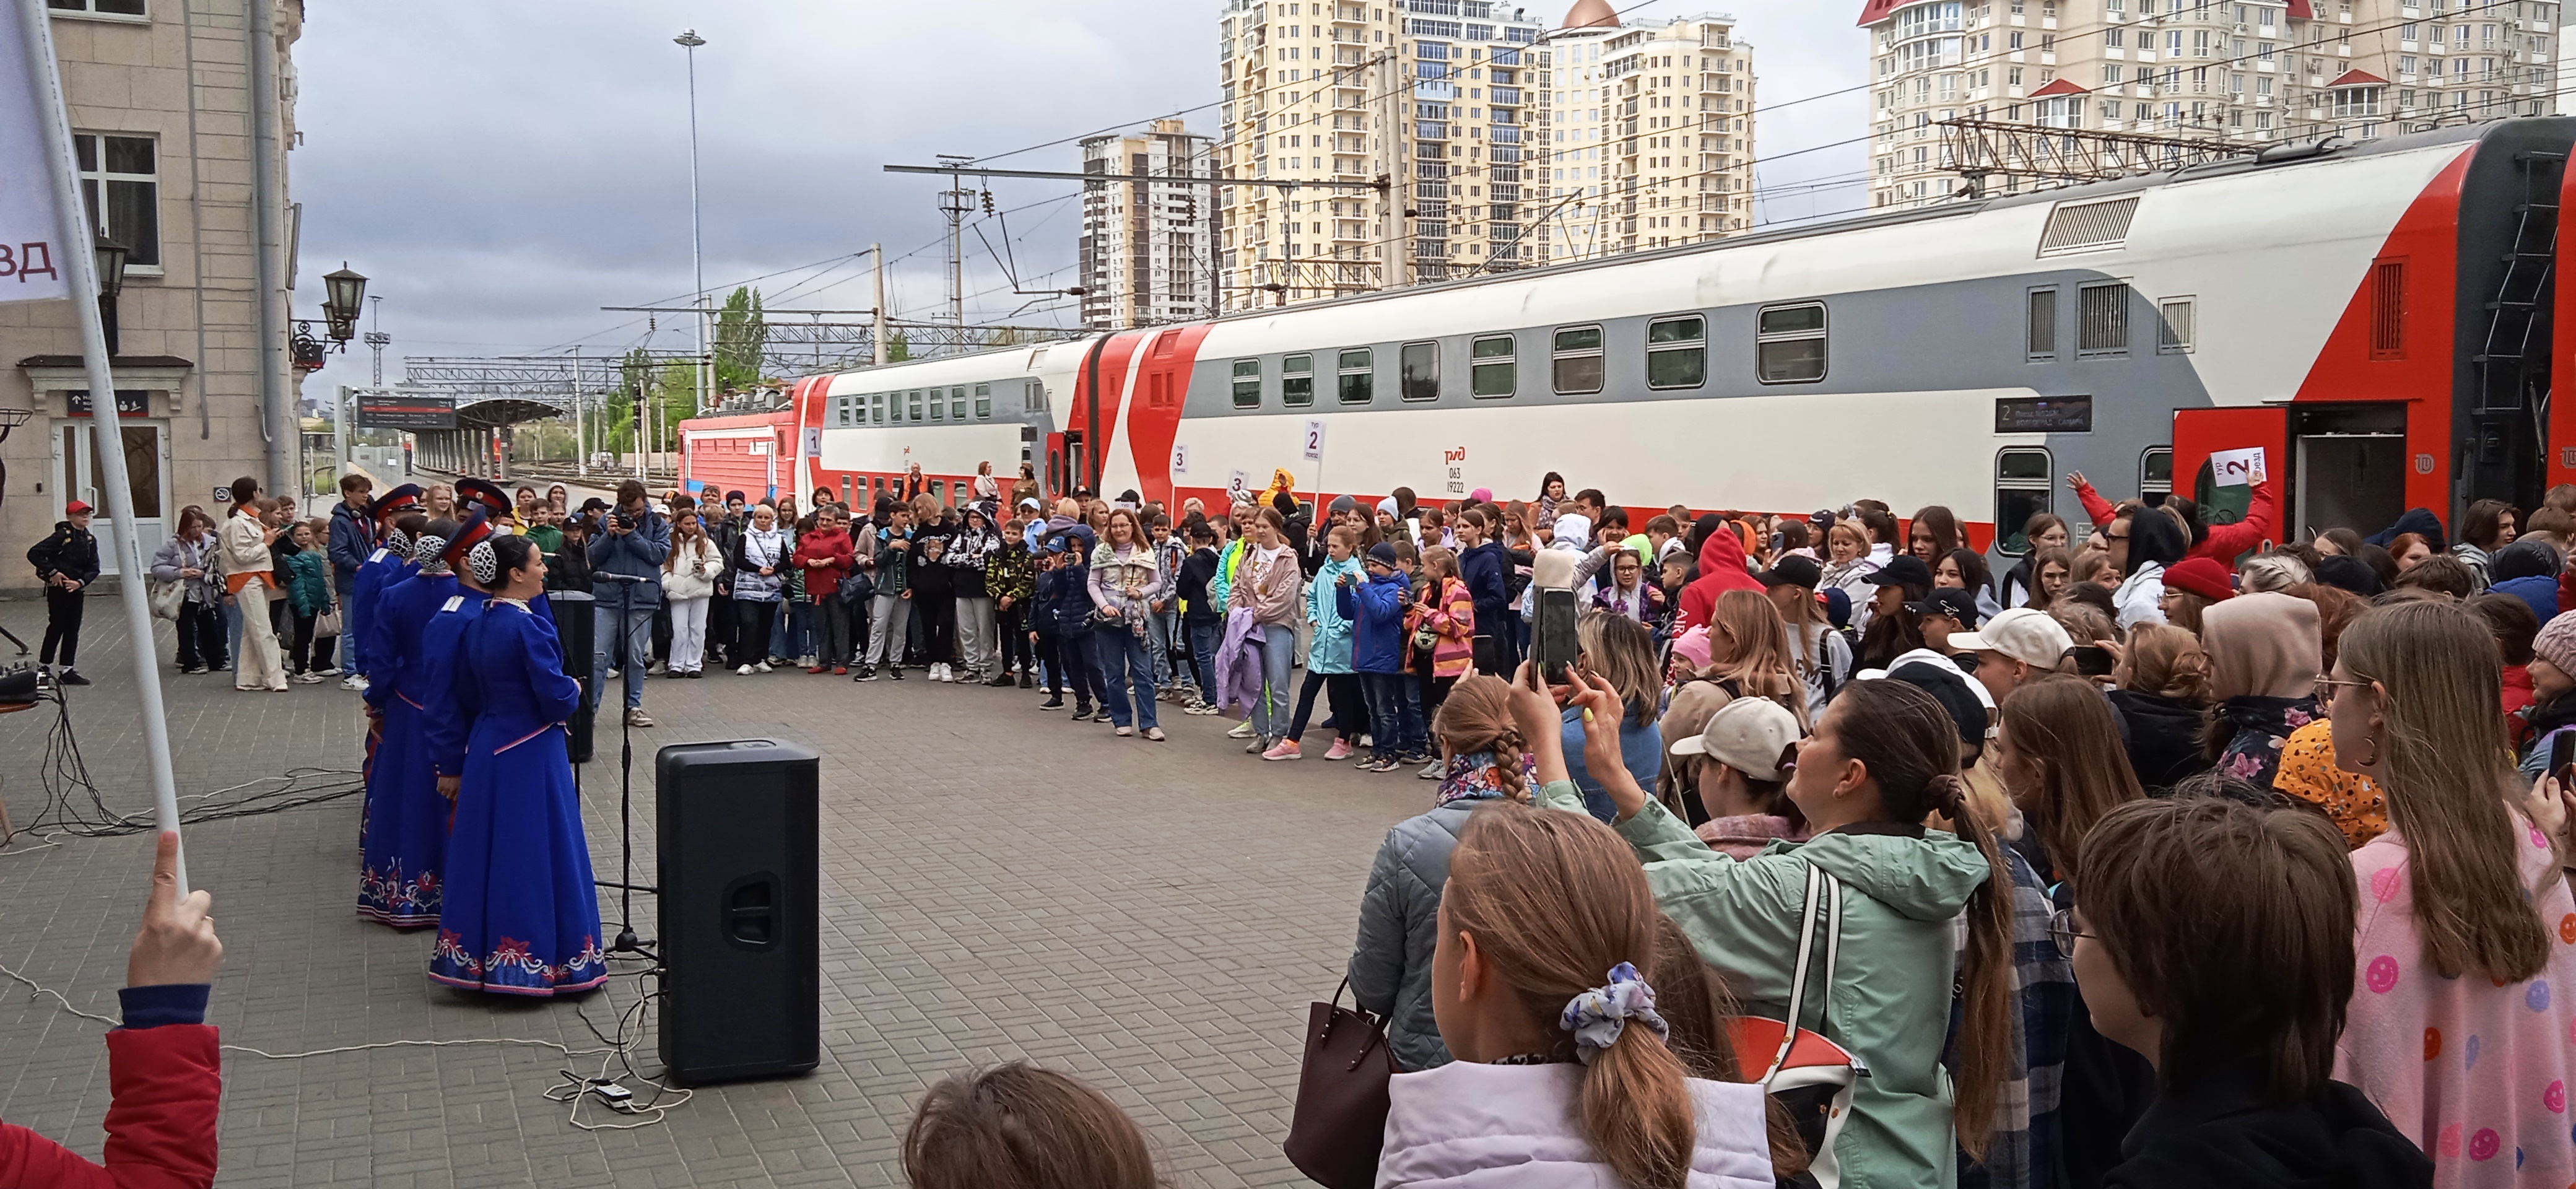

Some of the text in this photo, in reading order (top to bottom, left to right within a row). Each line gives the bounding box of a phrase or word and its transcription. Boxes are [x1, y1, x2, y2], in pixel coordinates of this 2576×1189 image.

[2002, 405, 2011, 421] 2
[811, 435, 817, 448] 1
[1308, 431, 1318, 450] 2
[1176, 453, 1183, 466] 3
[1449, 467, 1461, 479] 063
[2215, 462, 2224, 476] тур
[2226, 459, 2250, 475] 2
[1232, 478, 1242, 492] 3
[1447, 481, 1464, 494] 19222
